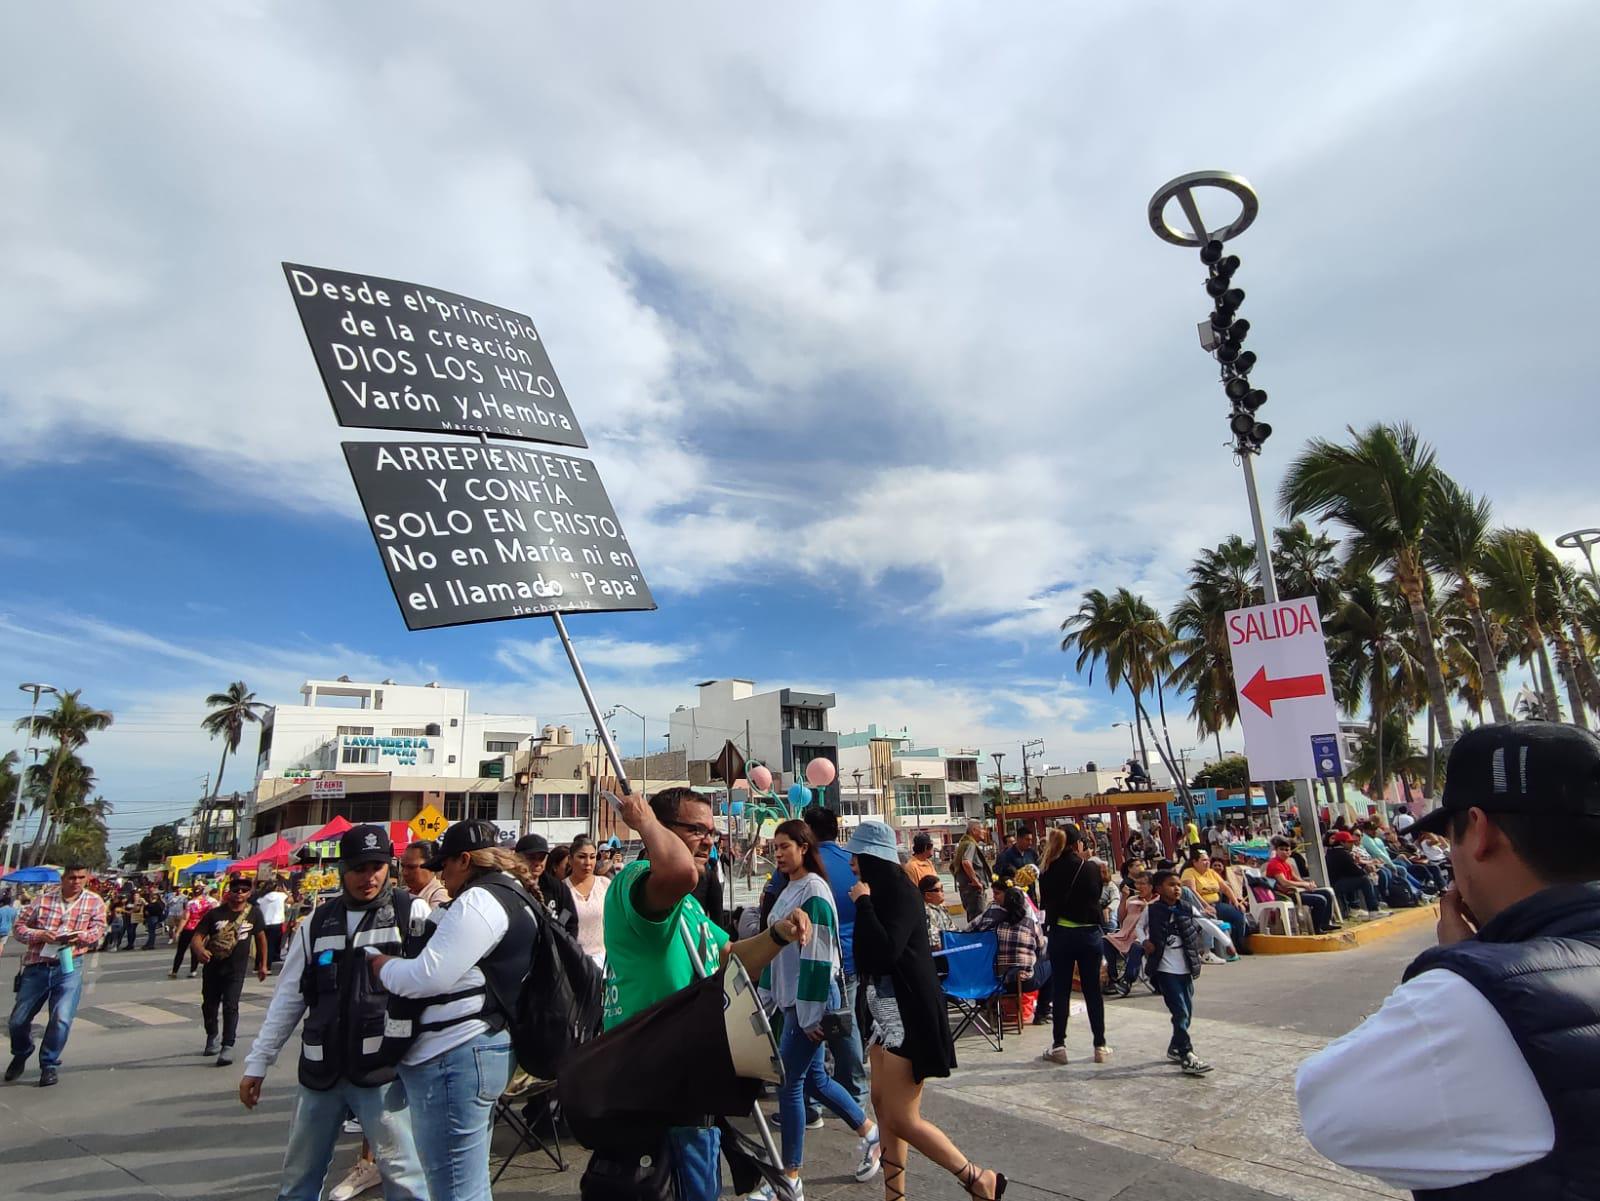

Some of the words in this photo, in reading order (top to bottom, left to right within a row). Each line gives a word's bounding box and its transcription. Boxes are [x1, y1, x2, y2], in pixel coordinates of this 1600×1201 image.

[290, 270, 391, 308] Desde
[403, 290, 427, 313] el
[437, 299, 539, 342] principio
[341, 311, 377, 338] de
[386, 315, 415, 342] la
[428, 327, 532, 367] creación
[331, 343, 418, 377] DIOS
[425, 353, 484, 384] LOS
[494, 365, 556, 399] HIZO
[342, 379, 441, 413] Varón
[453, 395, 471, 420] y
[481, 391, 573, 432] Hembra
[441, 420, 491, 433] Marcos
[376, 446, 588, 482] ARREPIENTETE
[426, 478, 448, 503] Y
[464, 474, 574, 506] CONFÍA
[373, 509, 474, 540] SOLO
[484, 508, 528, 533] EN
[387, 544, 438, 573] No
[451, 546, 488, 567] en
[494, 537, 574, 565] María
[581, 544, 604, 565] ni
[609, 550, 635, 568] en
[407, 582, 439, 611] el
[445, 573, 564, 607] llamado
[512, 603, 562, 616] Hechos
[1229, 603, 1318, 646] SALIDA
